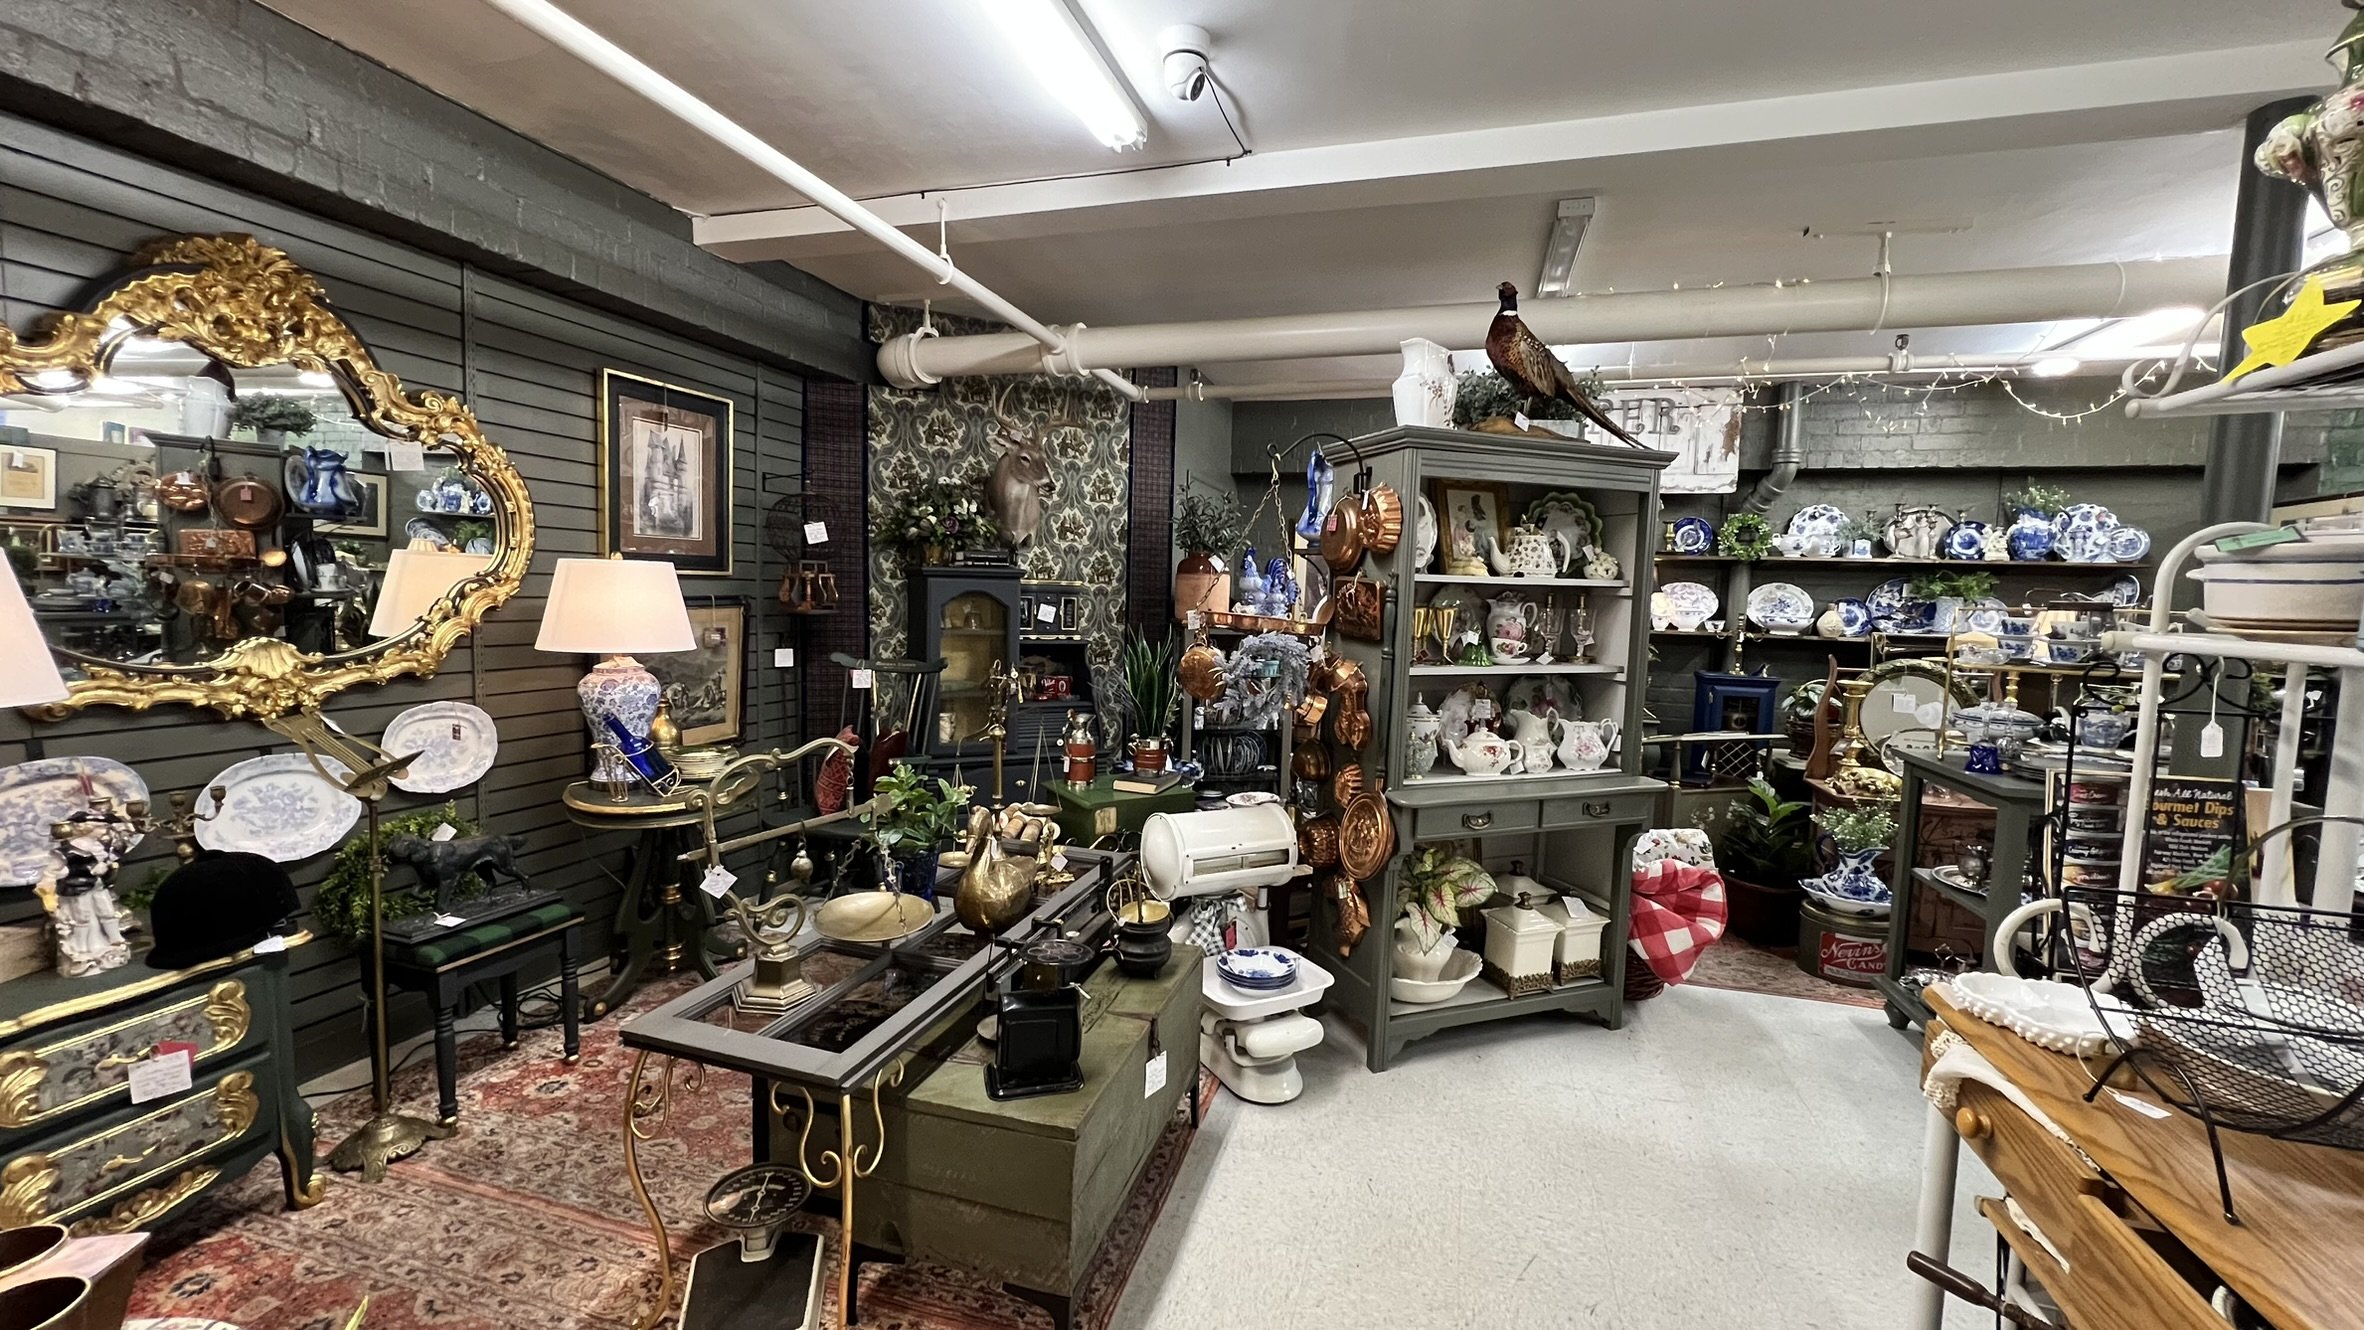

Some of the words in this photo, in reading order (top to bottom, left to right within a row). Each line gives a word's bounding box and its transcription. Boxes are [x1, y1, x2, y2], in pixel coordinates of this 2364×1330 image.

[2152, 801, 2200, 813] ourmet
[2204, 800, 2236, 819] Dips
[2155, 812, 2168, 826] &
[2173, 813, 2220, 829] Sauces
[1846, 957, 1886, 970] CAND
